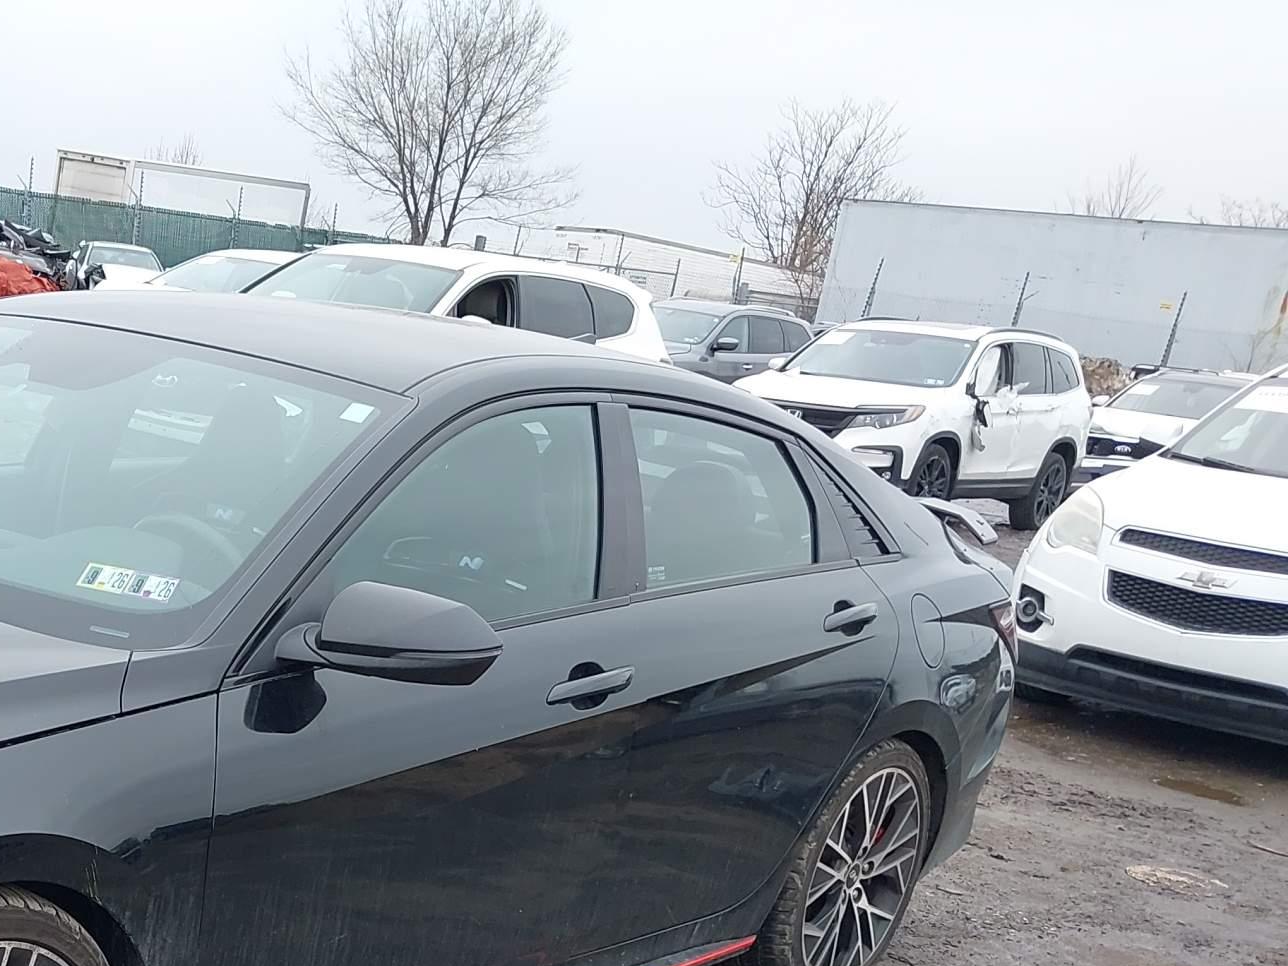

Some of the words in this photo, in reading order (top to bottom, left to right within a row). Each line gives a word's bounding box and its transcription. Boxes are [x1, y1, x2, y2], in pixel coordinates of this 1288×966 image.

[87, 569, 100, 585] 9
[111, 572, 129, 590] 26
[132, 578, 145, 594] 9
[158, 581, 175, 599] 26
